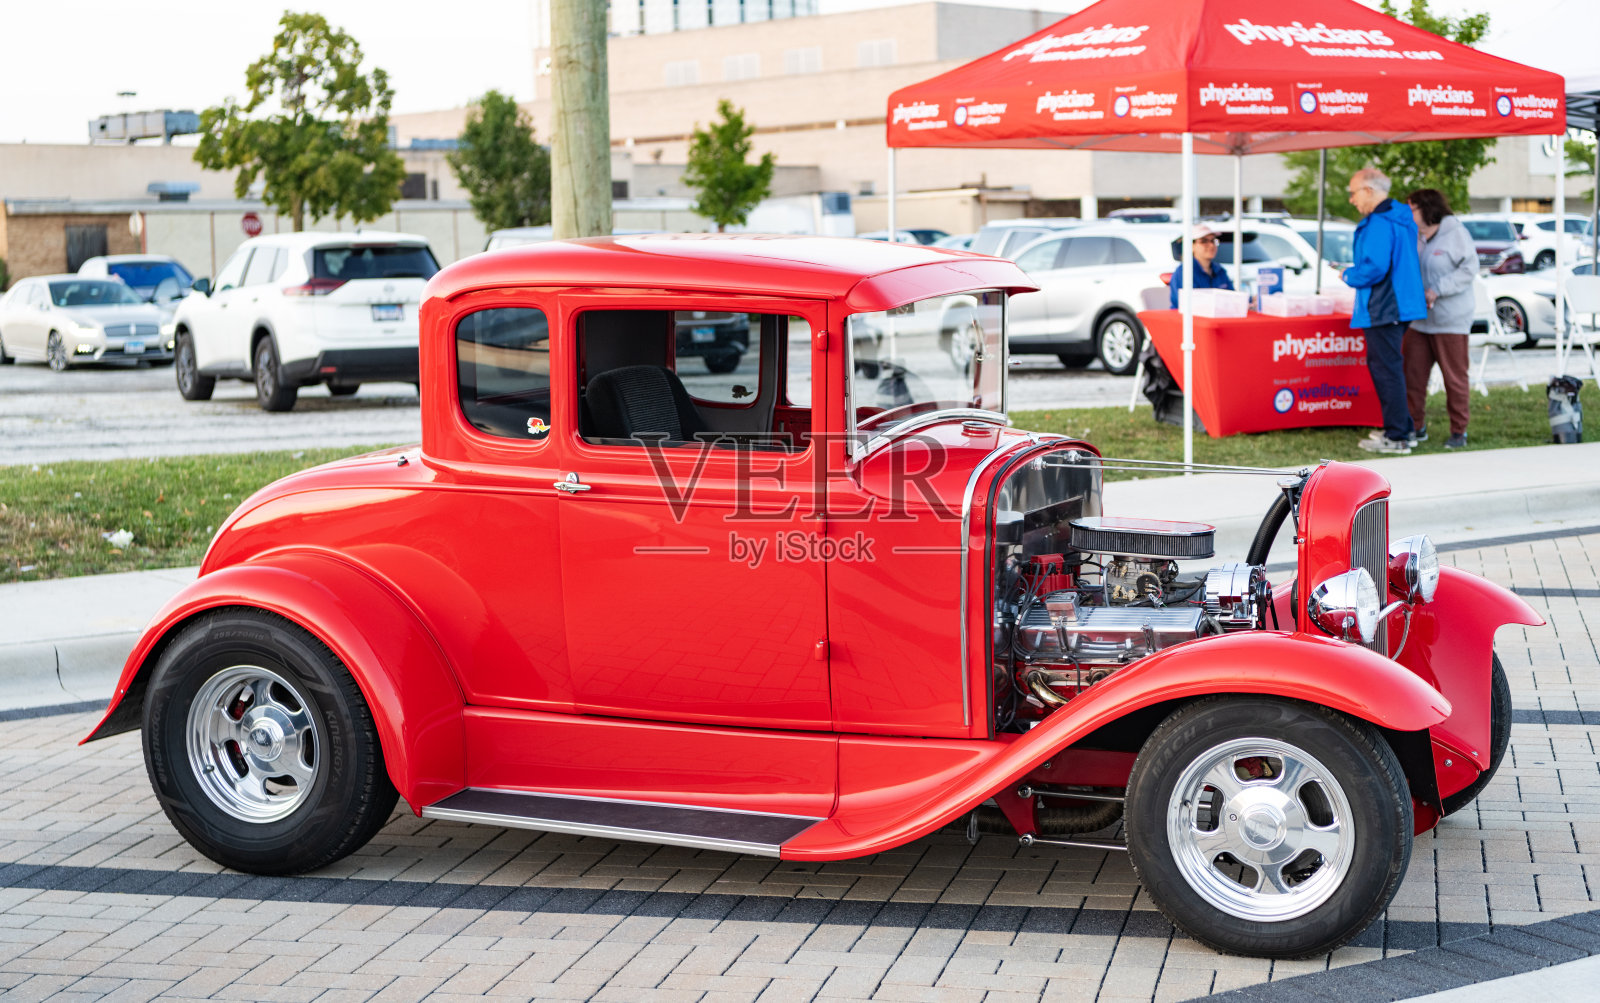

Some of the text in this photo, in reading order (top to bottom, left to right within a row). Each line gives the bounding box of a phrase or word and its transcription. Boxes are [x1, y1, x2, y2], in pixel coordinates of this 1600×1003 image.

[1223, 18, 1395, 47] physicians
[1036, 89, 1095, 114] physicians
[1199, 82, 1274, 107] physicians
[1317, 89, 1369, 104] wellnow
[1407, 84, 1474, 107] physicians
[1512, 94, 1558, 109] wellnow
[1272, 331, 1365, 362] physicians
[1305, 354, 1357, 368] immediate
[1298, 383, 1360, 399] wellnow
[1298, 398, 1352, 413] Urgent Care
